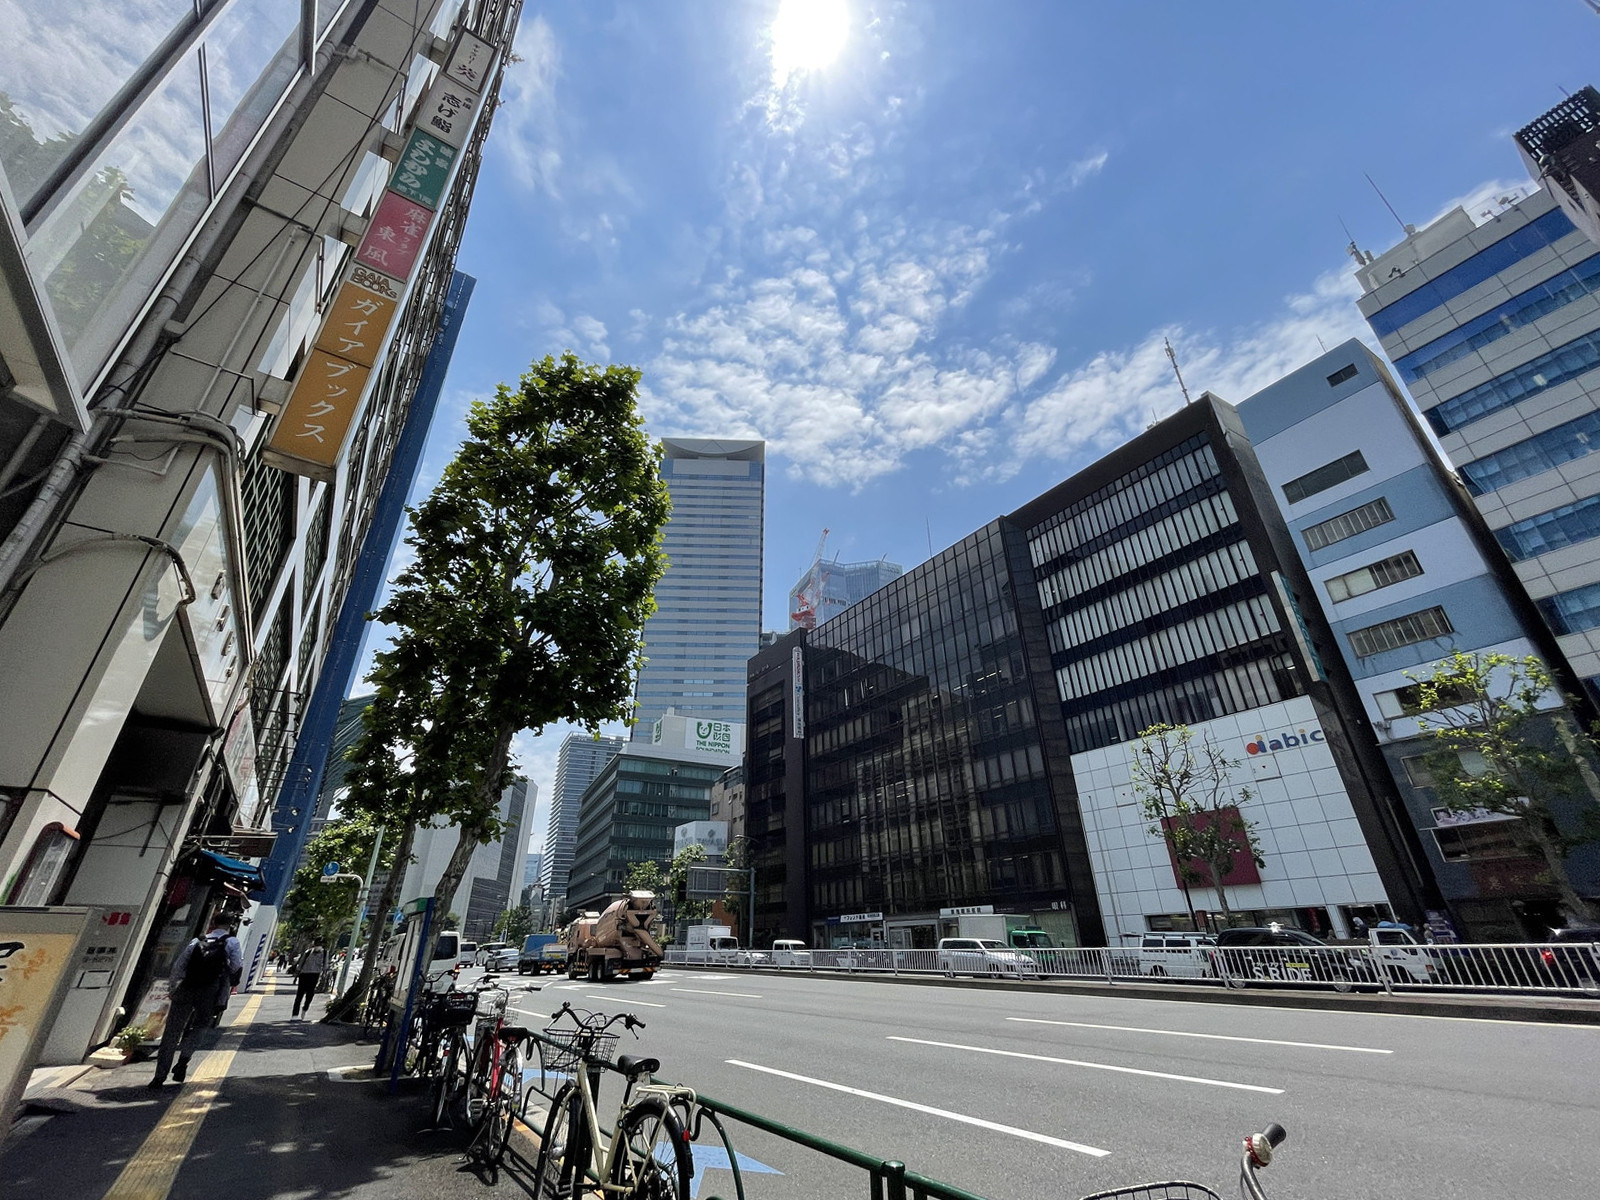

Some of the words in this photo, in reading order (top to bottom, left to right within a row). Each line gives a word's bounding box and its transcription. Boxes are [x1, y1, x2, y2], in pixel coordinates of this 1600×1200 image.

[350, 273, 398, 299] BOOKS
[354, 266, 391, 291] GAIA
[295, 298, 384, 444] ガイアブックス
[713, 722, 731, 732] 日本
[707, 741, 730, 749] NIPPON
